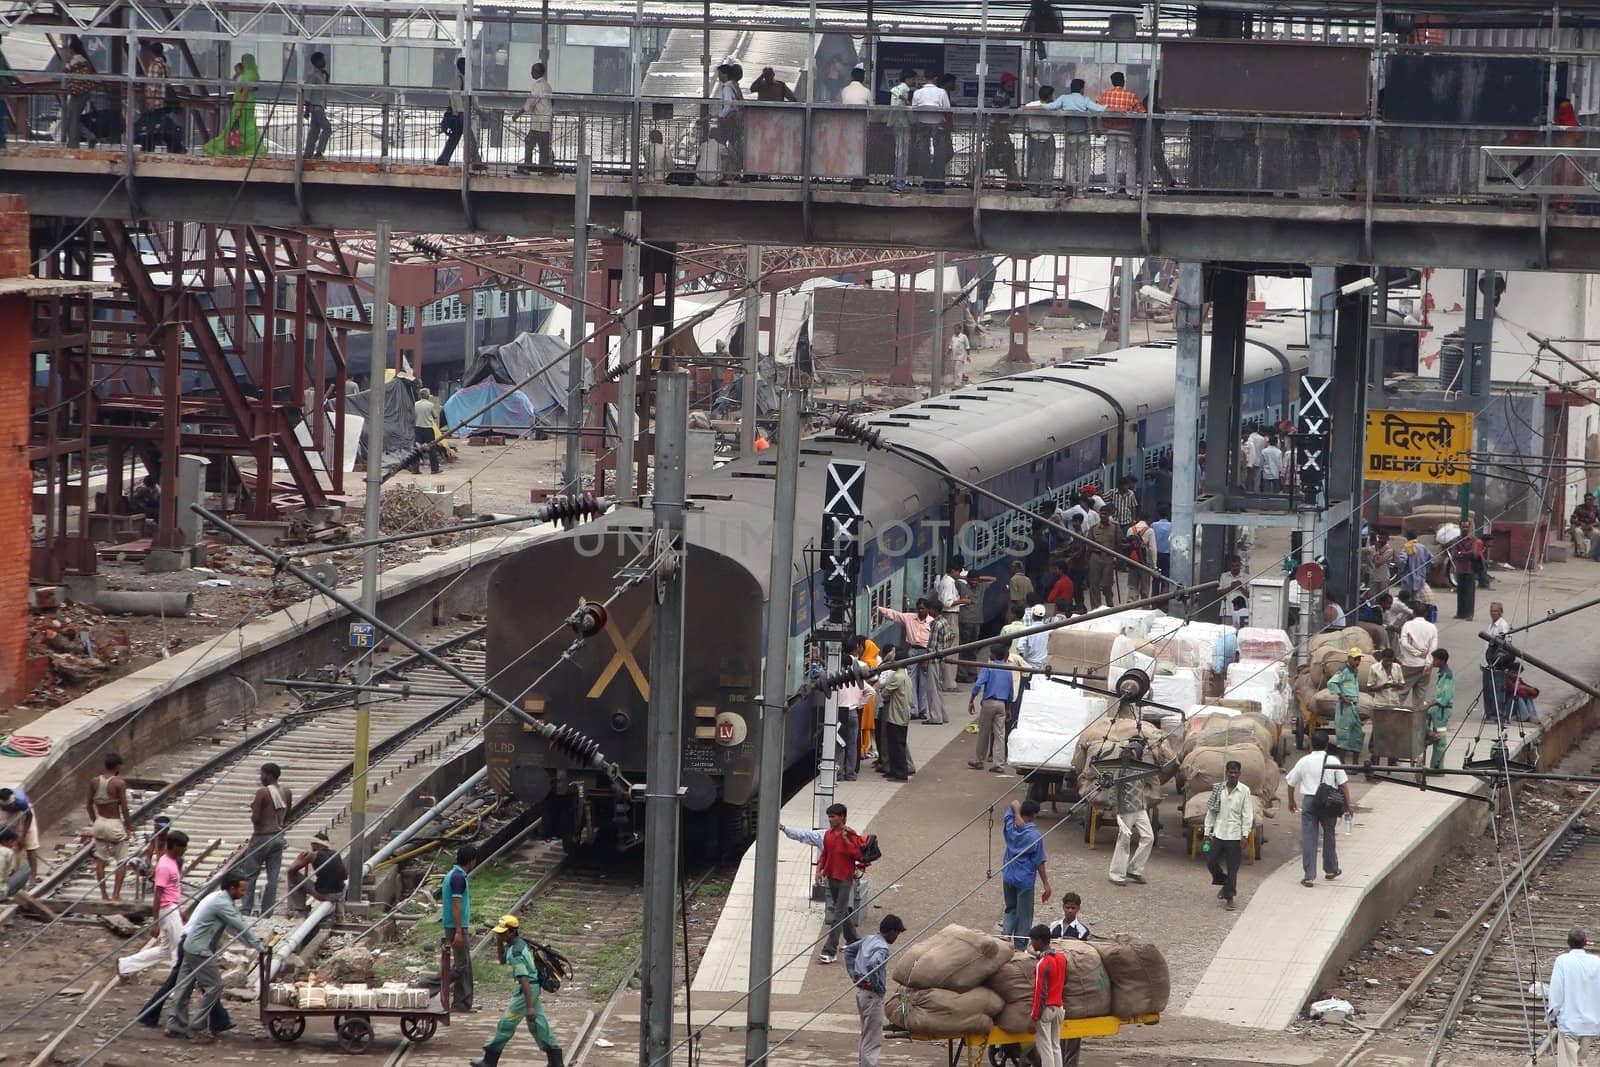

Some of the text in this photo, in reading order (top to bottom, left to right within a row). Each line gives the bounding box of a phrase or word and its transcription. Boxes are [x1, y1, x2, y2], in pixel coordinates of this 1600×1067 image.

[1381, 414, 1455, 450] दिल्ली
[1370, 454, 1421, 472] DELHI
[720, 726, 734, 738] LV
